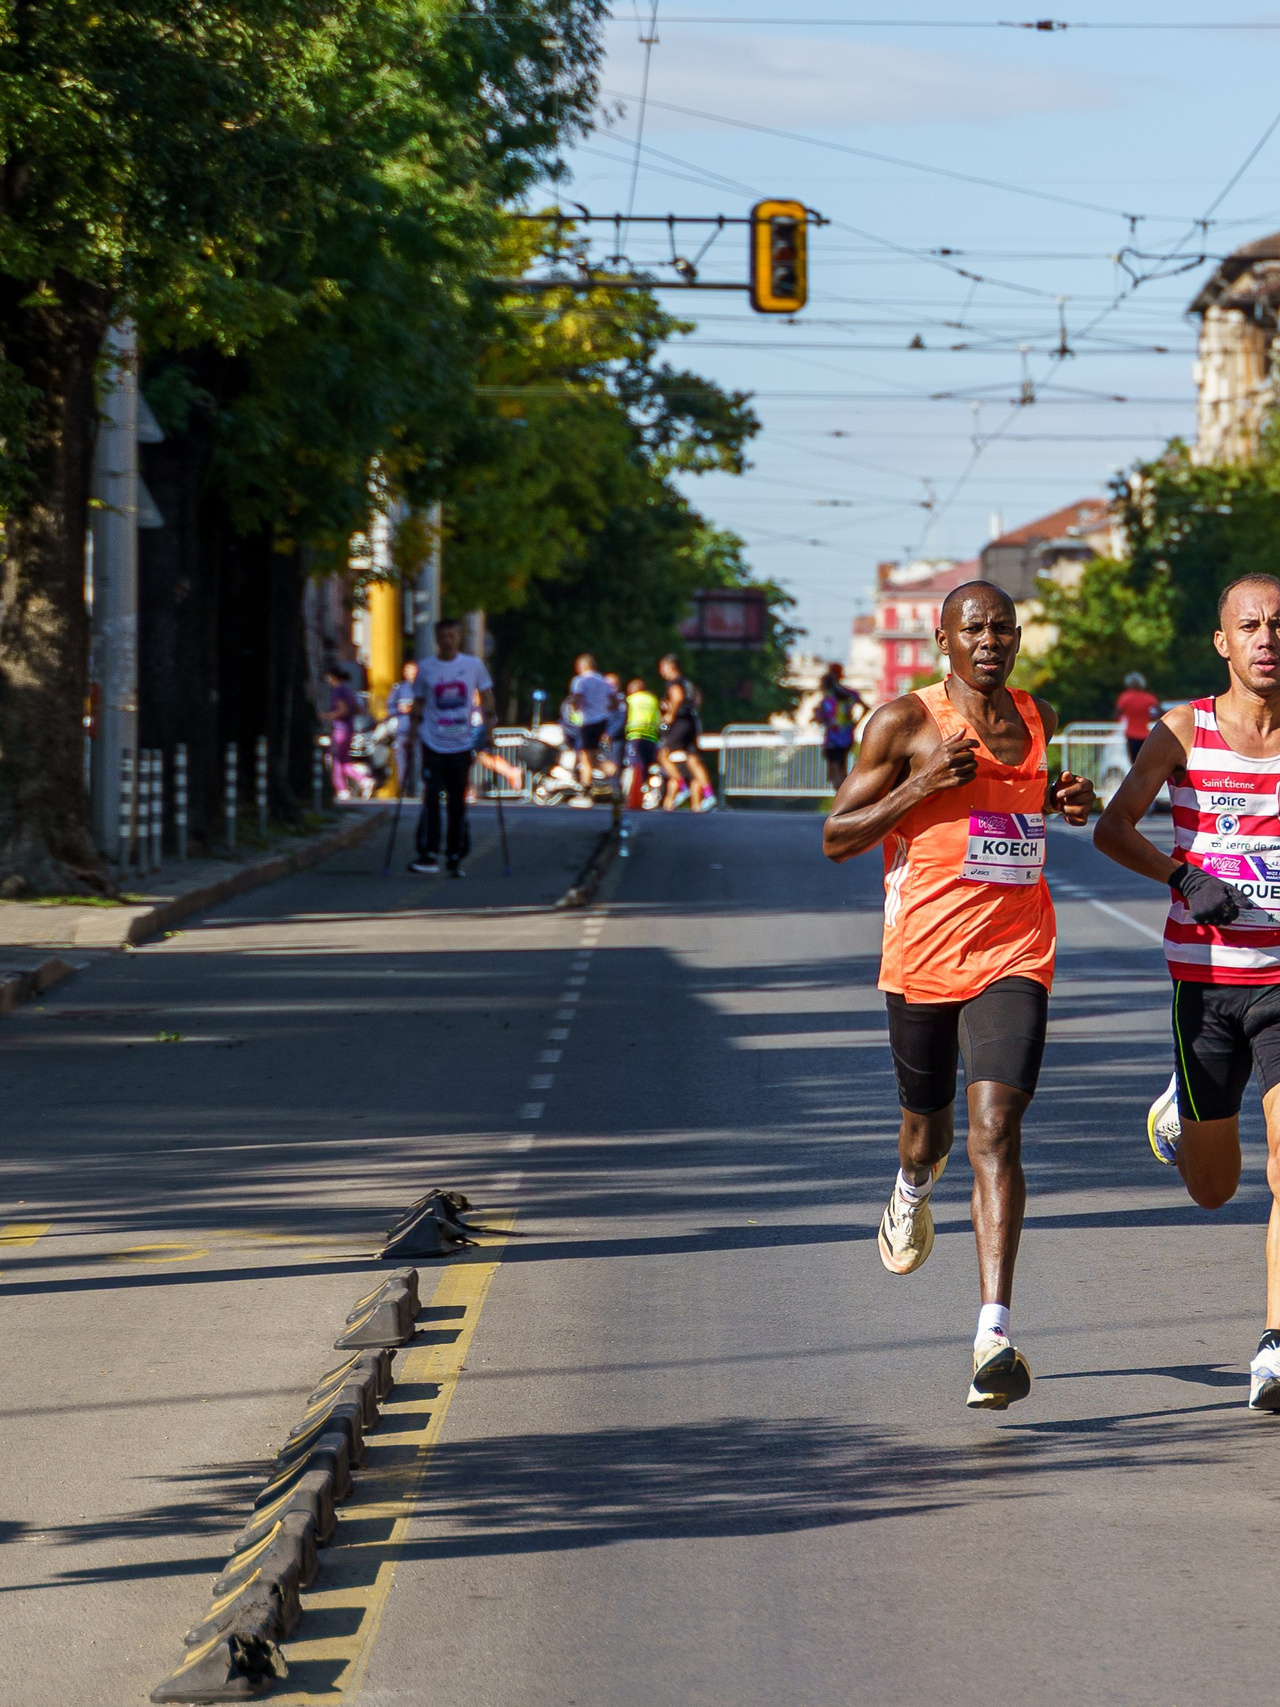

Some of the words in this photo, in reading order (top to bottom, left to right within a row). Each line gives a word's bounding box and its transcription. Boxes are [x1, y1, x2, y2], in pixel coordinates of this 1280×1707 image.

[1211, 795, 1246, 807] Loire
[982, 840, 1038, 857] KOECH
[1226, 841, 1251, 851] terre
[1253, 841, 1267, 852] de
